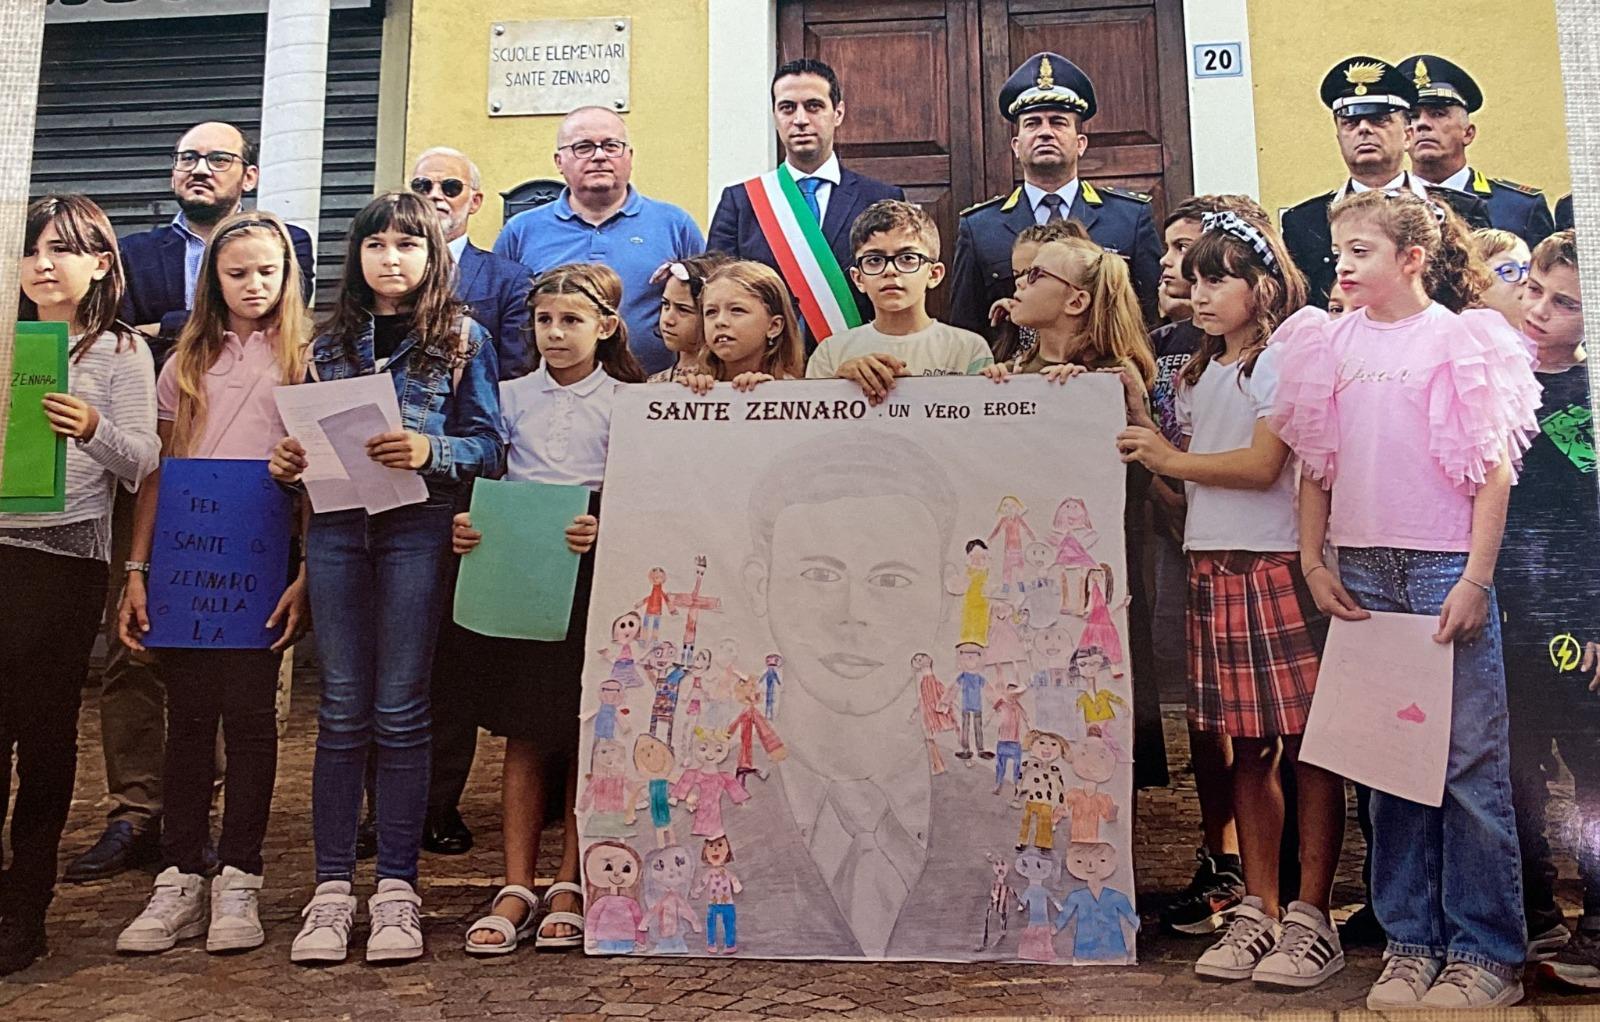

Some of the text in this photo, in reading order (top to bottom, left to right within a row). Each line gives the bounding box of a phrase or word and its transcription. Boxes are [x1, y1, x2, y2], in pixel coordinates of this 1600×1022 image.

[492, 43, 625, 62] SCUOLE ELEMENTARI
[1204, 49, 1232, 71] 20
[505, 69, 611, 87] SANTE ZENNARO
[1156, 353, 1192, 367] KEEP
[646, 400, 1037, 421] SANTE ZENNARO UN VERO EROE!
[174, 531, 230, 556] SANTE
[169, 570, 257, 592] ZENNARO
